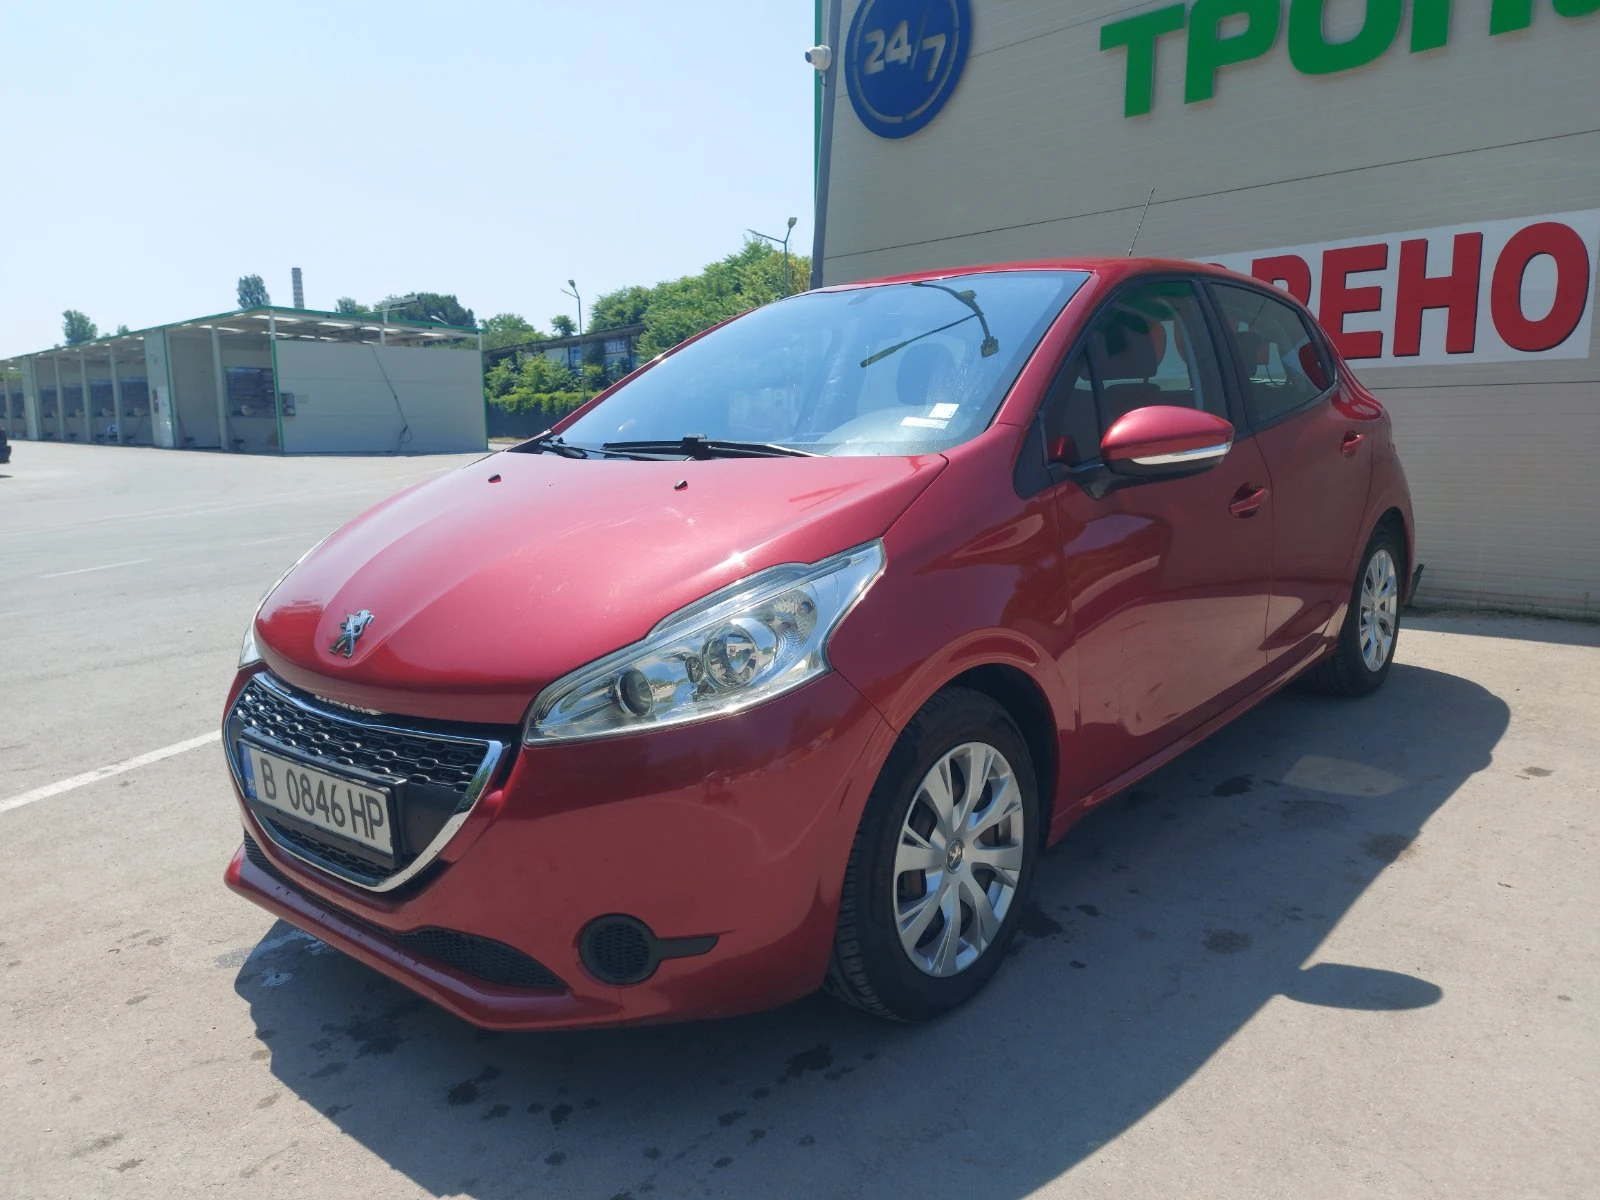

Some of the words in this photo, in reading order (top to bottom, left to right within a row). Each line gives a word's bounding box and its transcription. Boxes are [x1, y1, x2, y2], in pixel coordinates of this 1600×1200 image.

[863, 12, 946, 82] 24/7
[1206, 222, 1590, 360] РЕНО
[260, 757, 277, 800] B
[286, 768, 346, 828] 0846
[348, 788, 384, 840] HP
